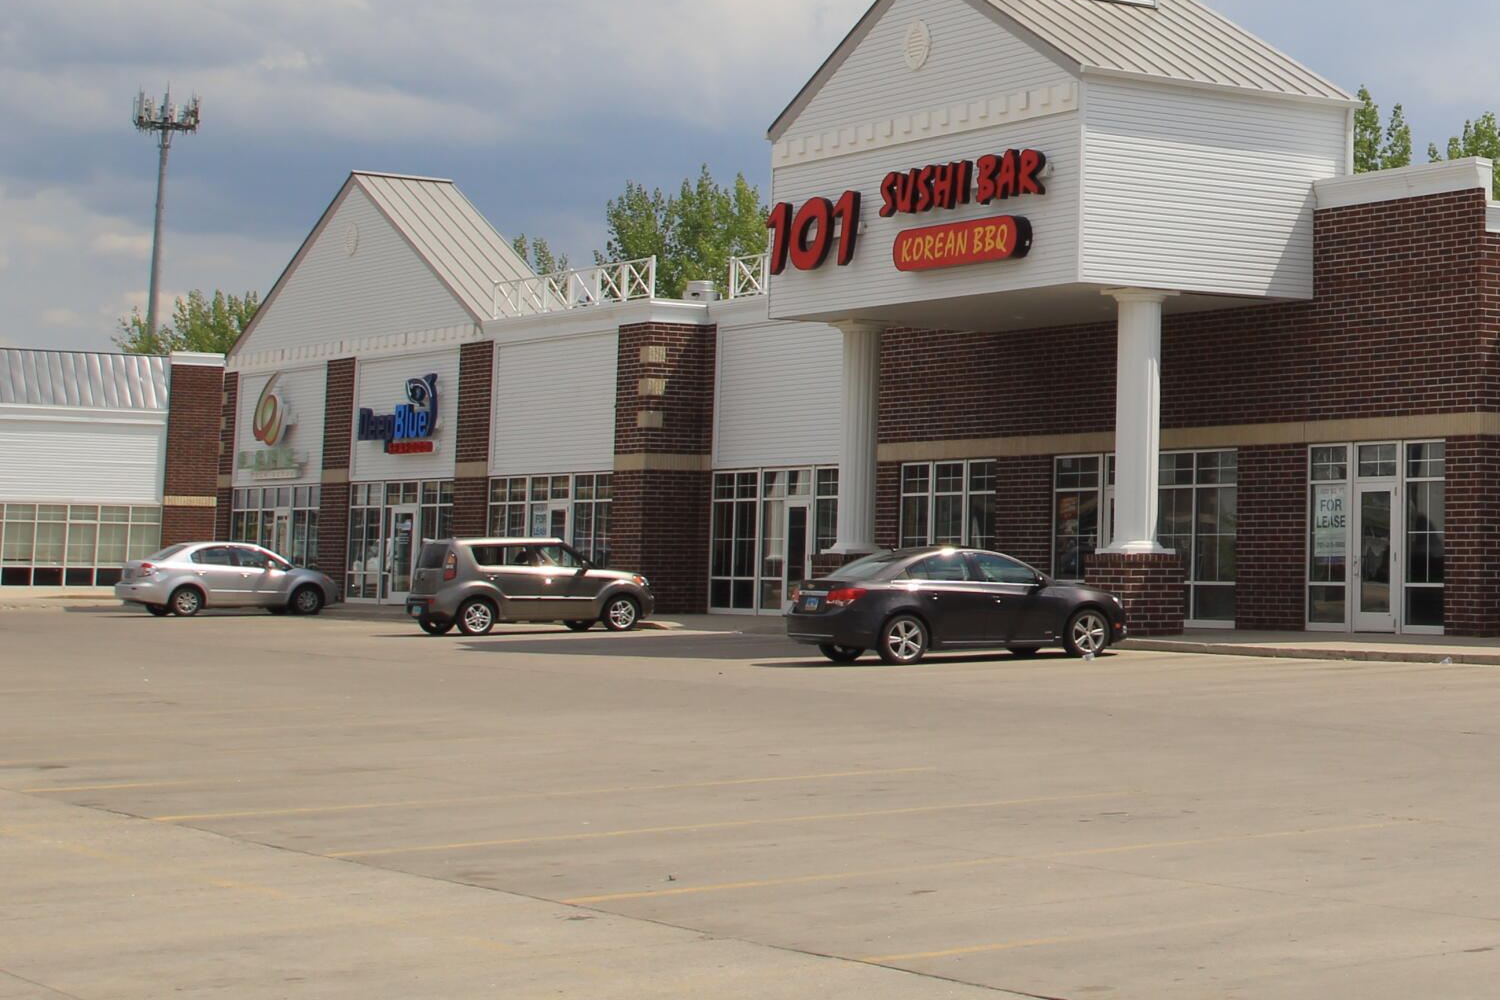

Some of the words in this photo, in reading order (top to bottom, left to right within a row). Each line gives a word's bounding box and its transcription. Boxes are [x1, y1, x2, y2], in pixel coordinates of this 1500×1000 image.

[879, 160, 973, 217] SUSHI
[975, 149, 1046, 205] BAR
[766, 190, 861, 275] 101
[901, 230, 968, 262] KOREAN
[972, 224, 1008, 253] BBQ
[1316, 516, 1346, 528] LEASE
[1320, 499, 1343, 511] FOR
